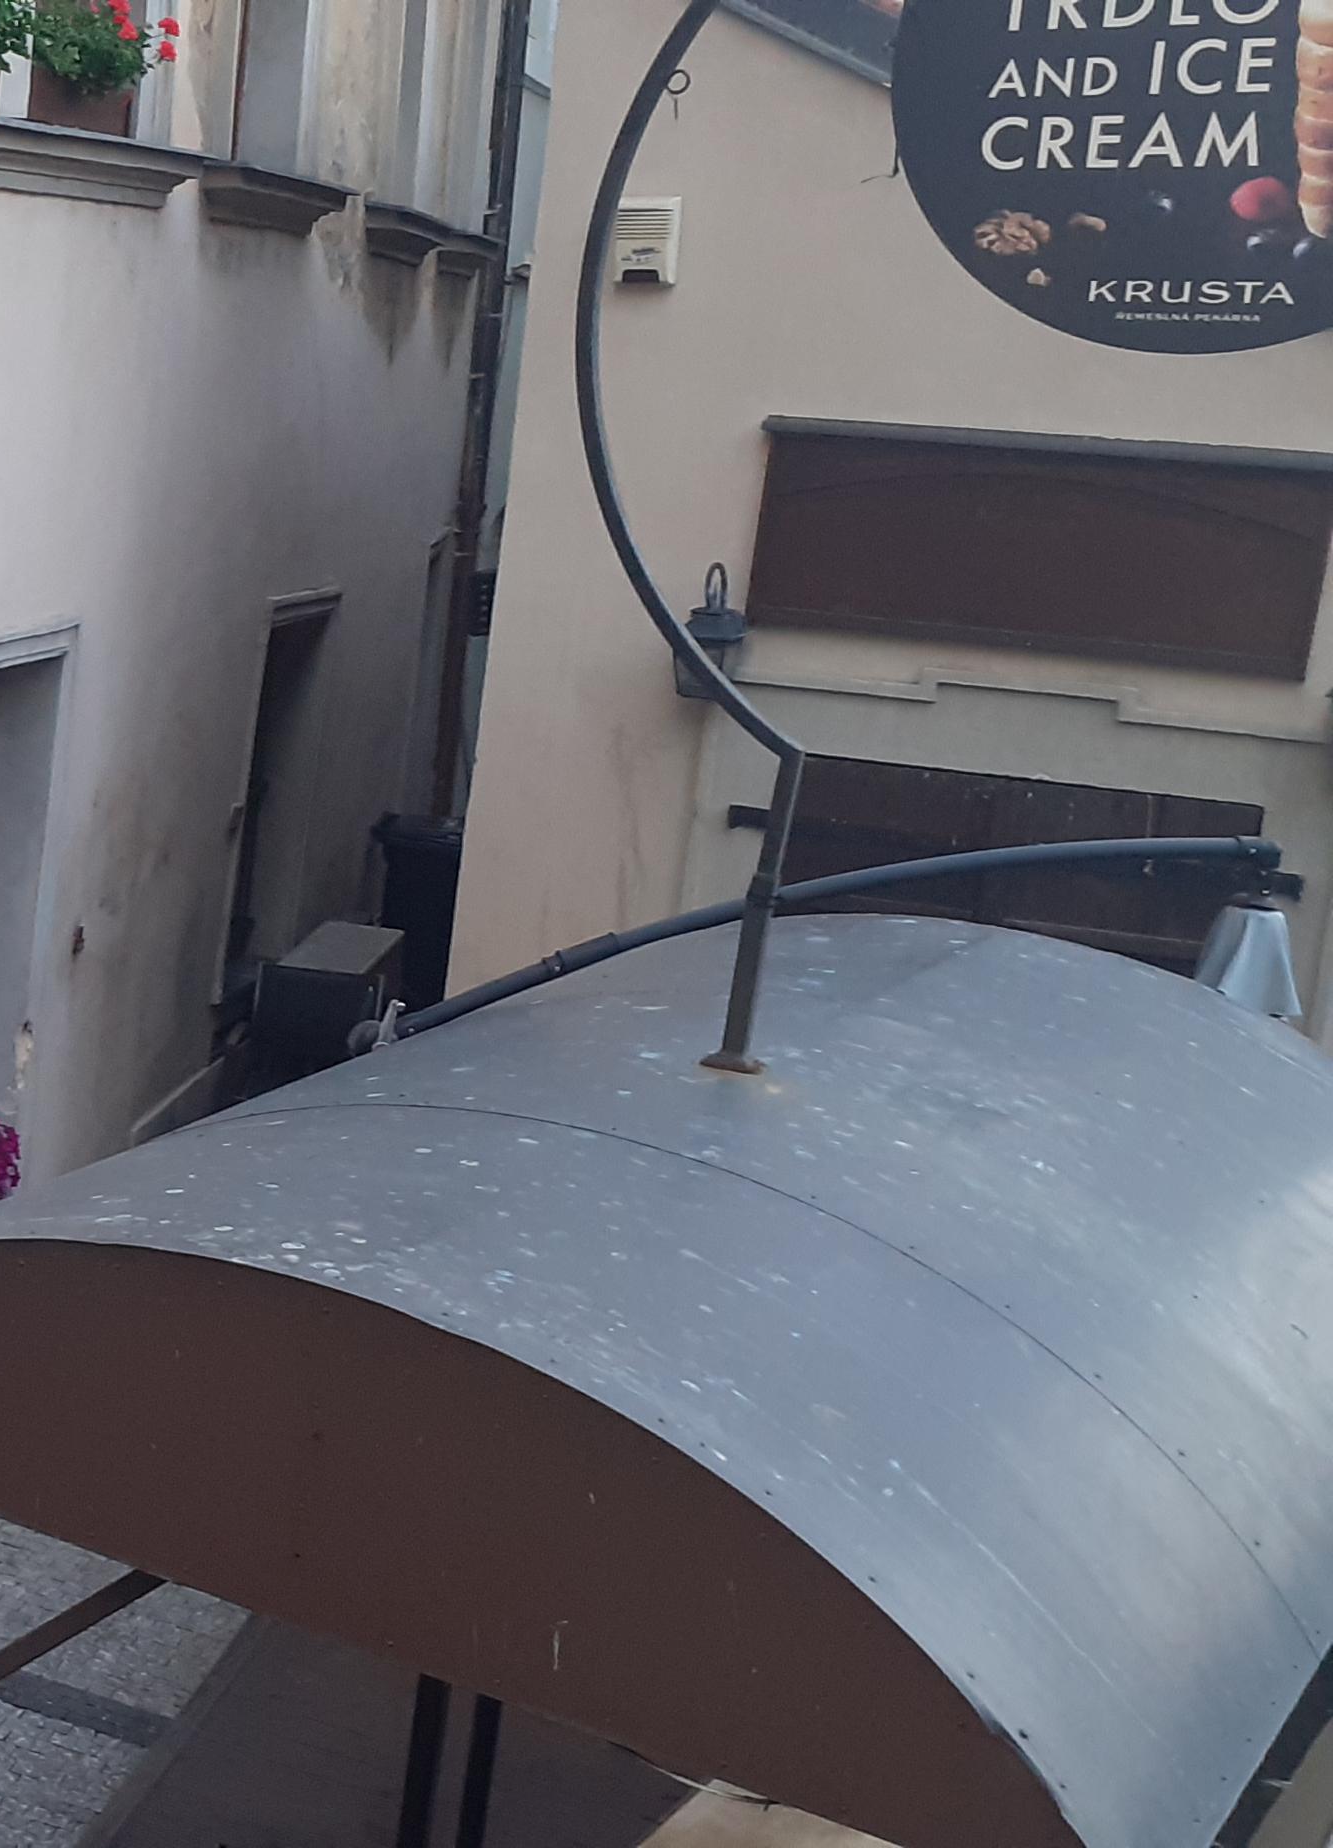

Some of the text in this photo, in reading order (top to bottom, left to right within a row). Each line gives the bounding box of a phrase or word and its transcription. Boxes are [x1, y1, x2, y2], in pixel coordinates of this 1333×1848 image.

[988, 37, 1276, 98] AND ICE
[981, 111, 1260, 171] CREAM
[1088, 280, 1295, 305] KRUSTA
